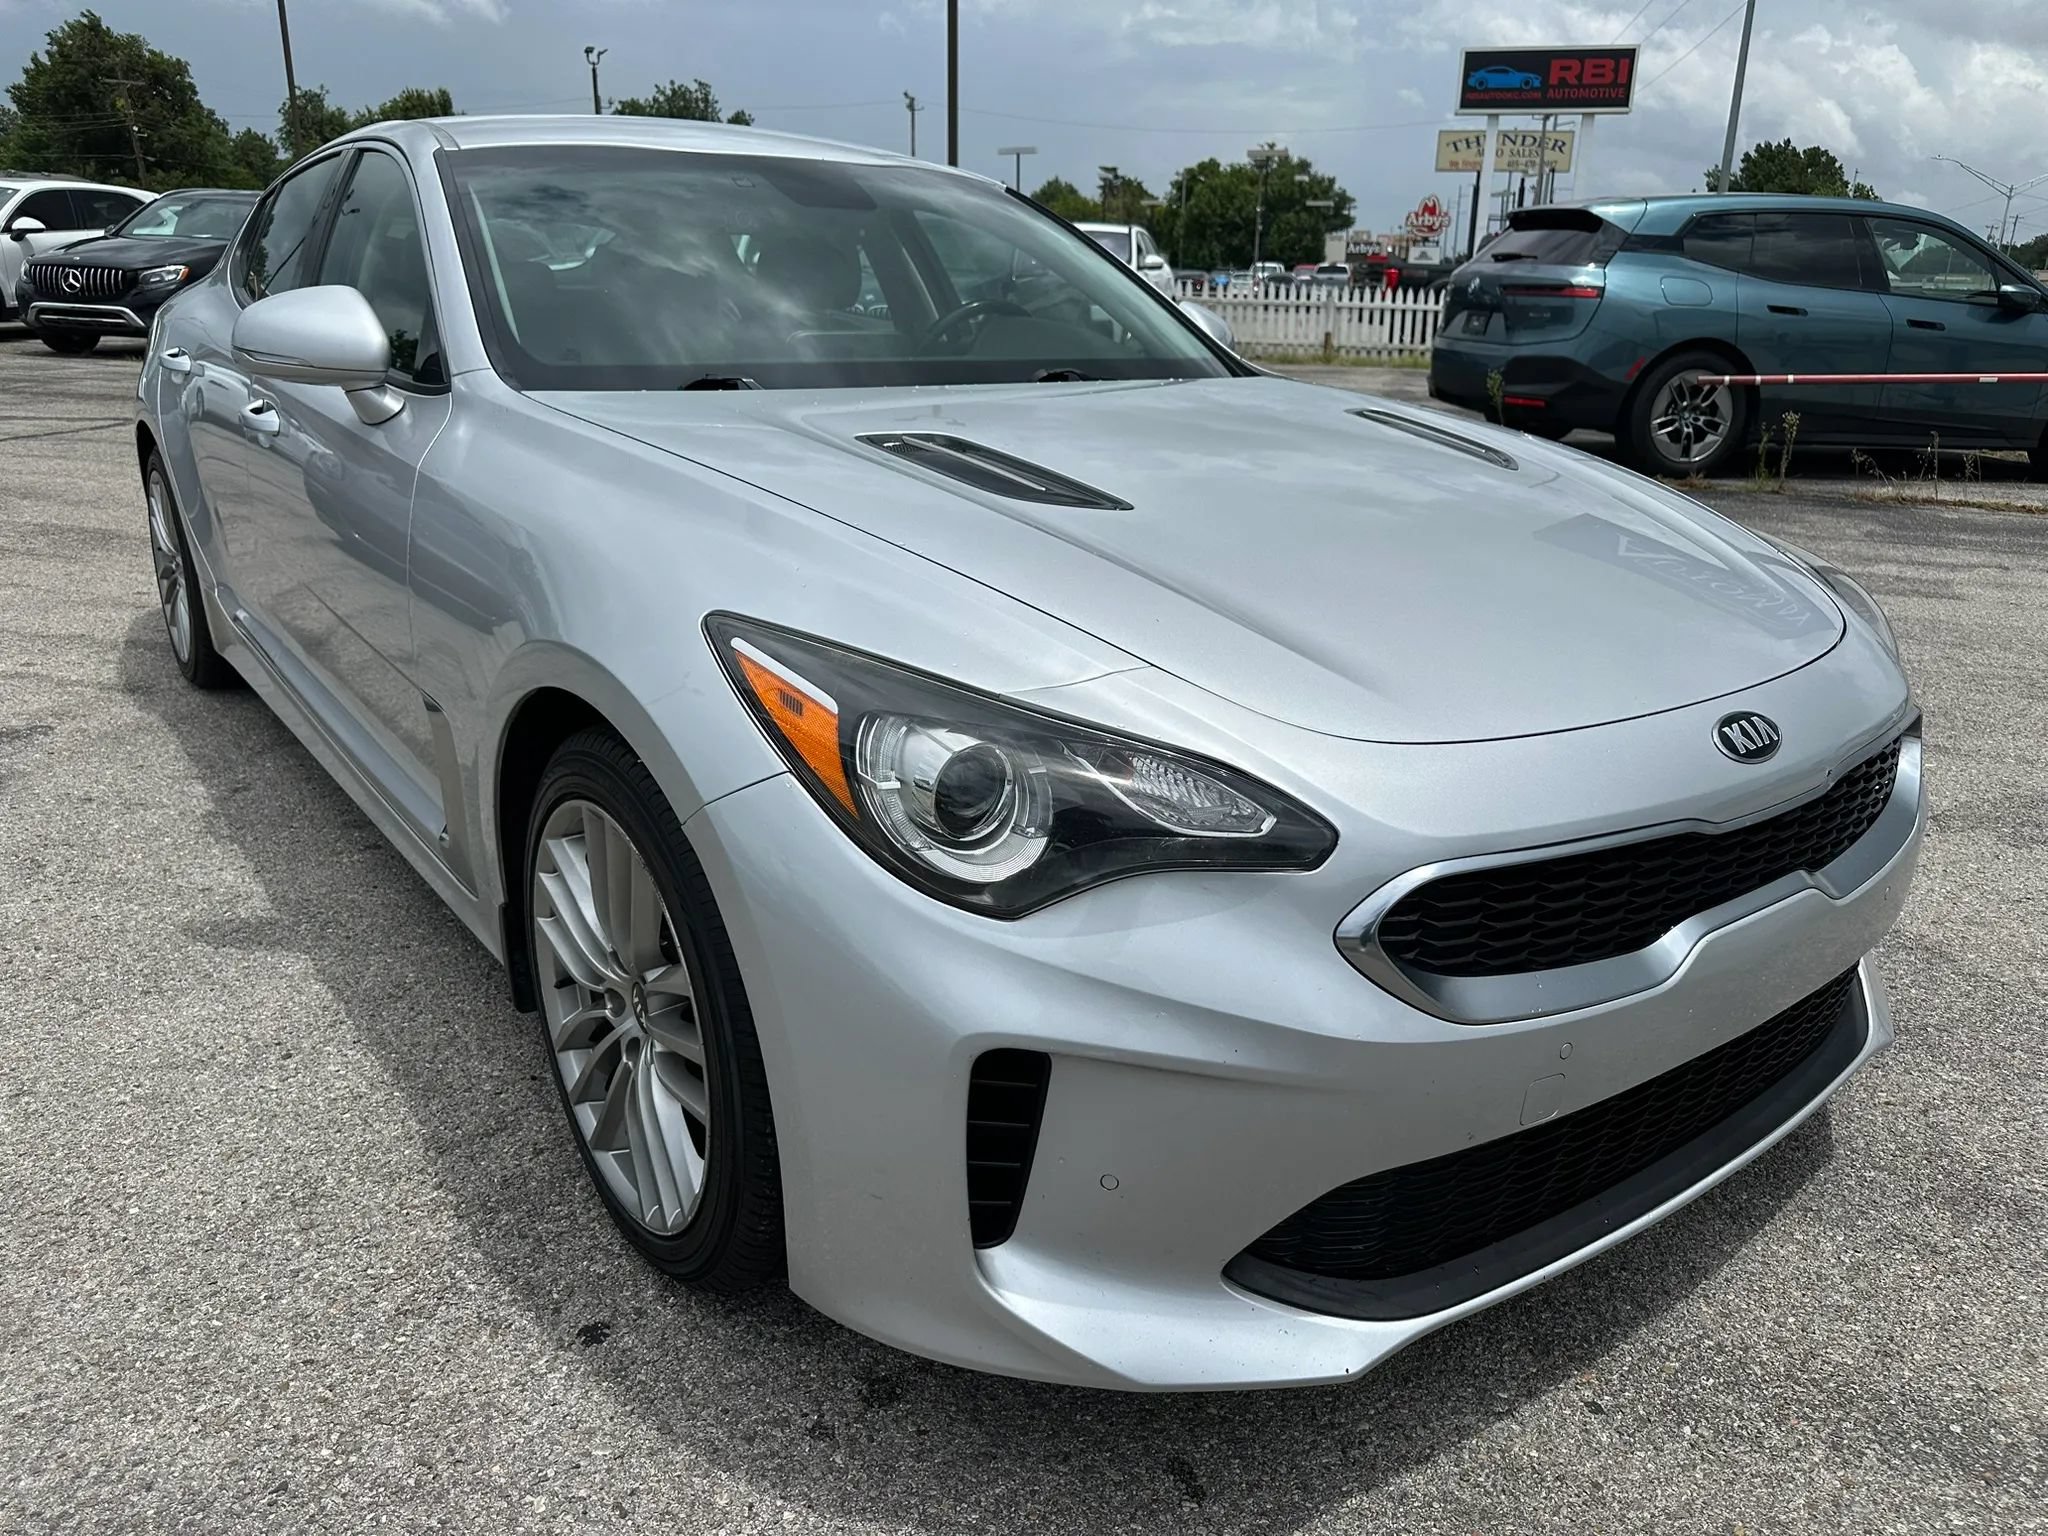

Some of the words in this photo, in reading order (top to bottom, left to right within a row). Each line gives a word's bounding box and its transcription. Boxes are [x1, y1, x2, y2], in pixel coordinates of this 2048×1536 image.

[1549, 58, 1630, 85] RBI
[1547, 88, 1625, 99] AUTOMOTIVE
[1446, 133, 1567, 155] THNDER
[1407, 213, 1450, 230] Arby's
[1347, 242, 1380, 256] Arby's
[1721, 716, 1779, 754] KIA
